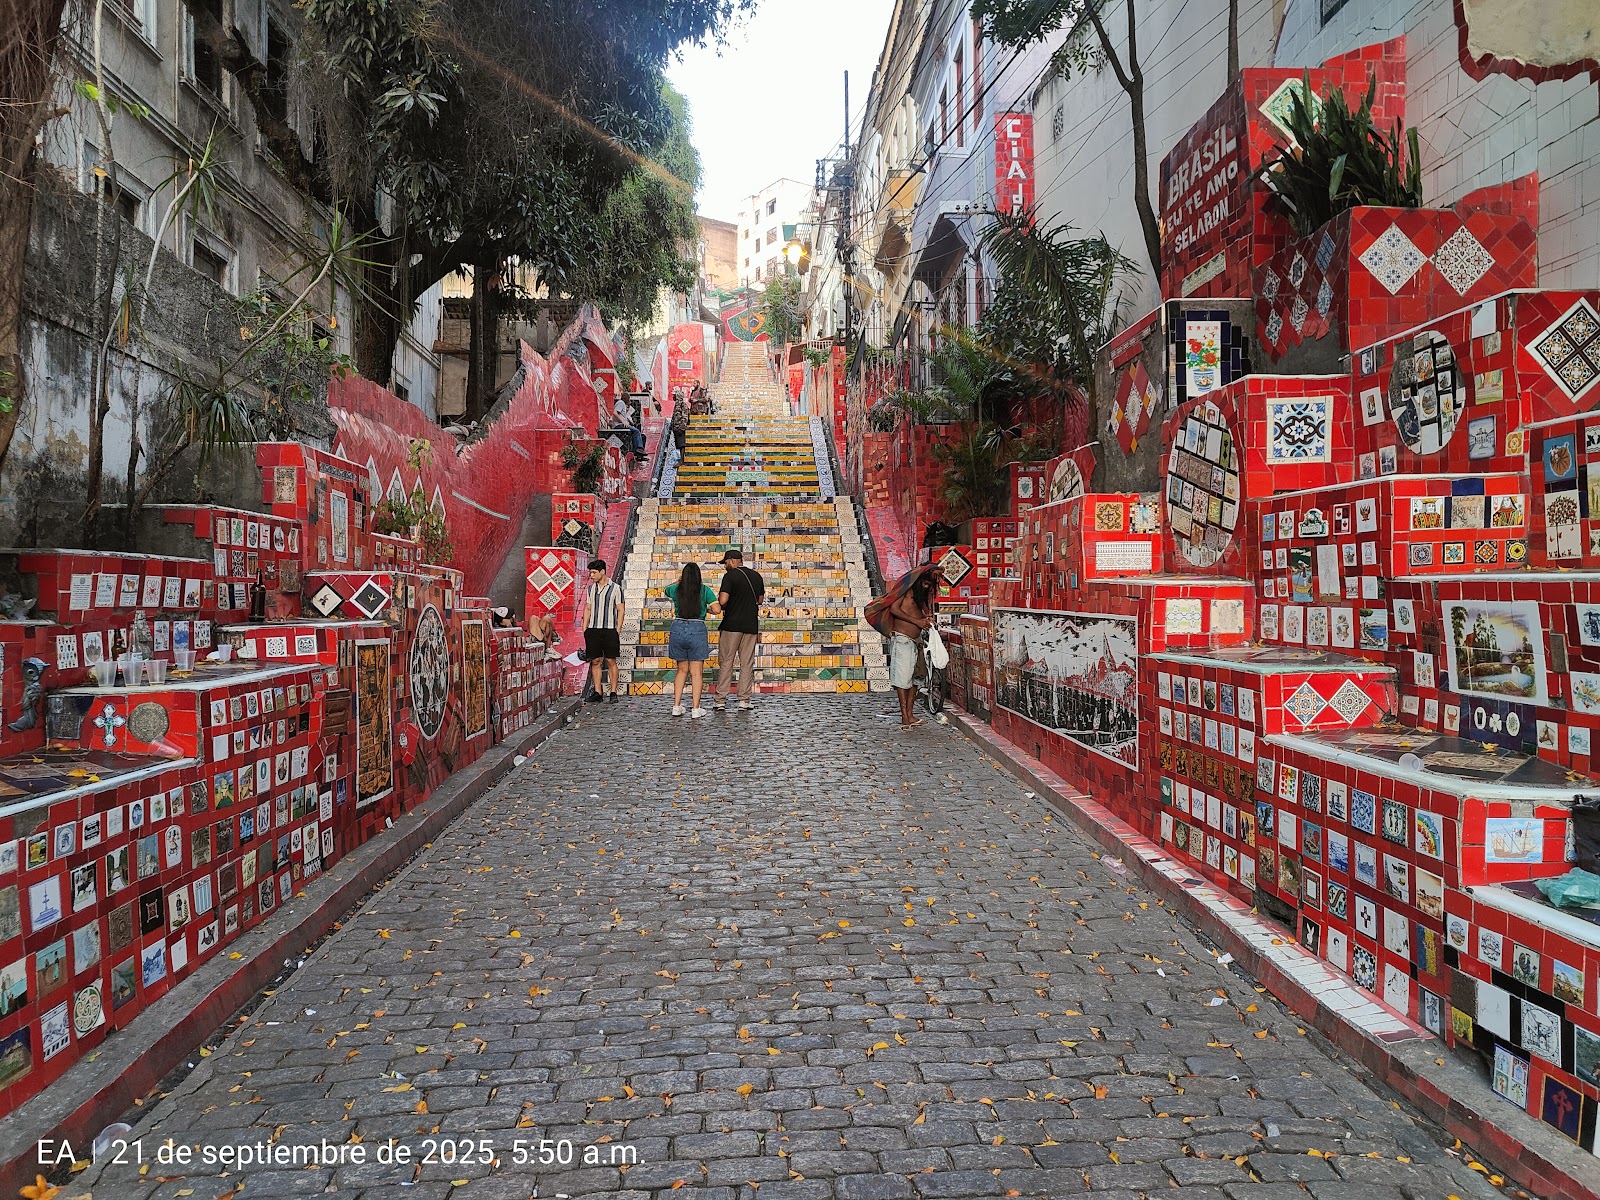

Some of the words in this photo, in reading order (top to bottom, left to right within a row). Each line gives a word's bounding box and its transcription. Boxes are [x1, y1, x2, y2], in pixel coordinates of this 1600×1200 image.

[1166, 210, 1183, 232] EU
[1185, 190, 1203, 215] TE
[1206, 160, 1238, 201] AMO
[1175, 196, 1229, 254] SELARON
